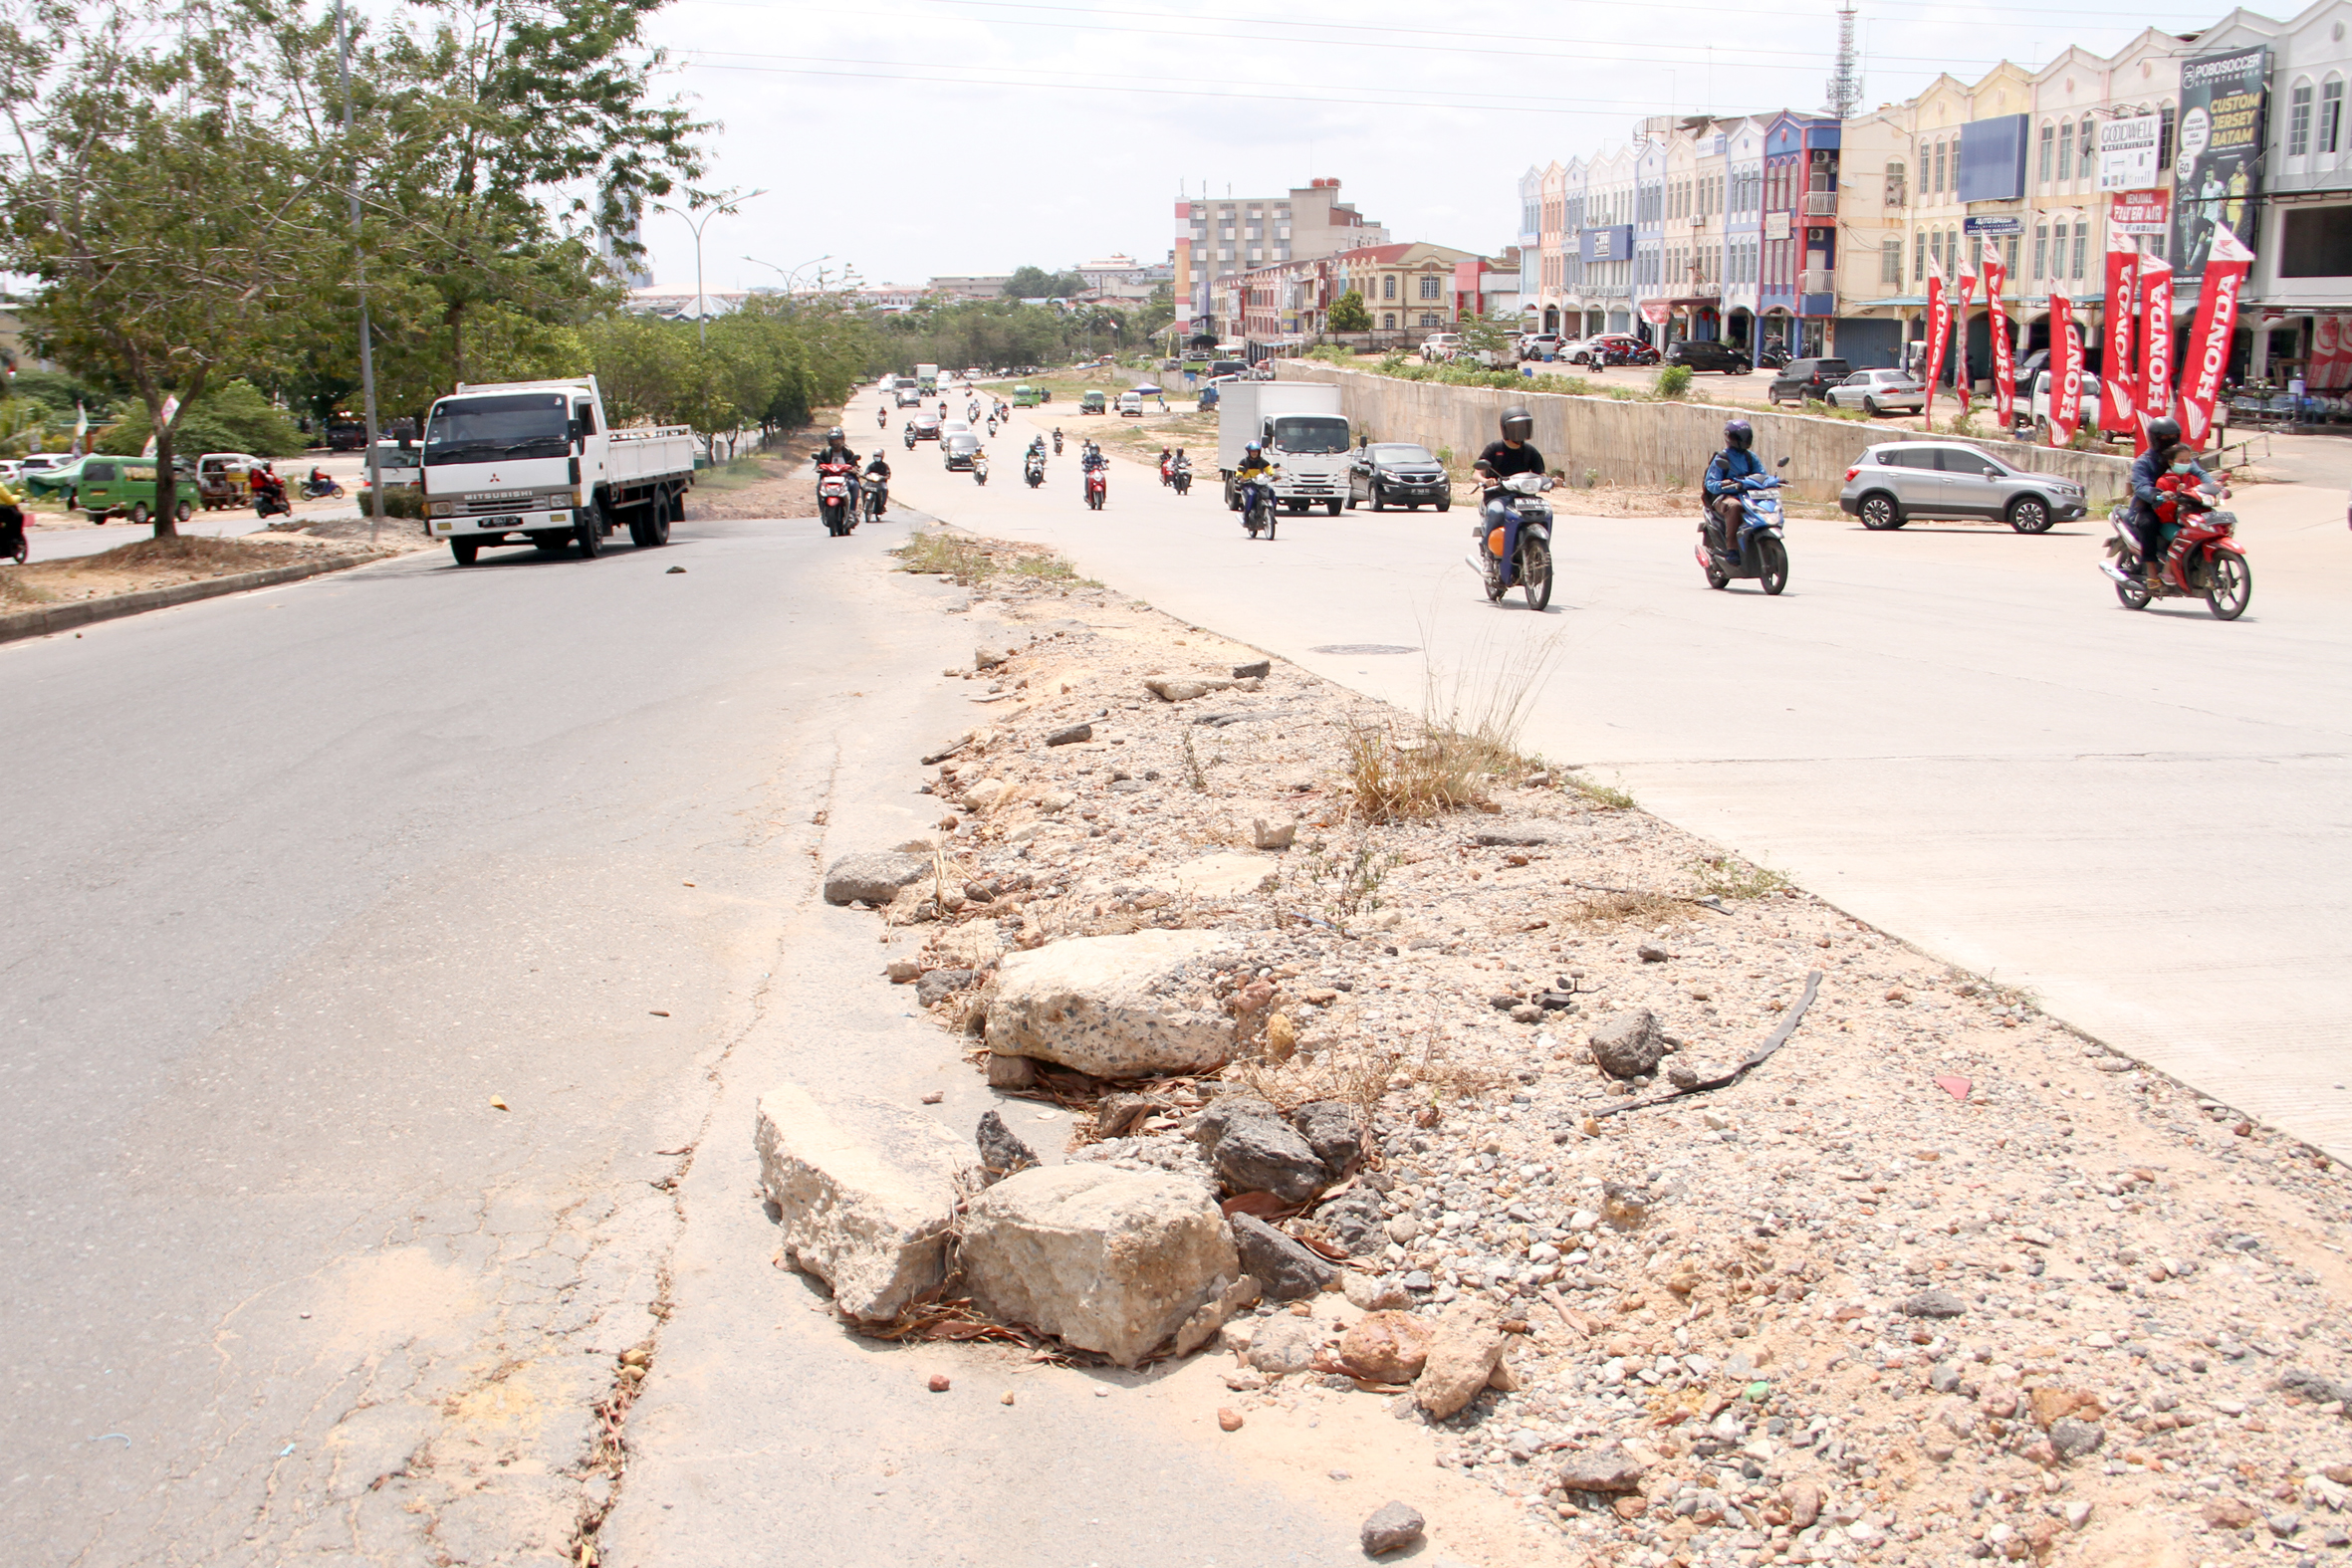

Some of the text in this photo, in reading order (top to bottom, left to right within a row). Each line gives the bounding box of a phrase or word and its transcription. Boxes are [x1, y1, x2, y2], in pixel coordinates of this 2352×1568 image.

[2195, 53, 2261, 79] POBOSOCCER
[2210, 92, 2261, 113] CUSTOM
[2101, 119, 2154, 142] GOODWELL
[2211, 110, 2256, 130] JERSEY
[2211, 126, 2254, 147] BATAM
[2113, 205, 2163, 221] FILTER AIR
[2115, 264, 2134, 385] HONDA
[2147, 281, 2168, 410] HONDA
[2196, 273, 2236, 401] HONDA
[464, 490, 533, 501] MITSUBISHI
